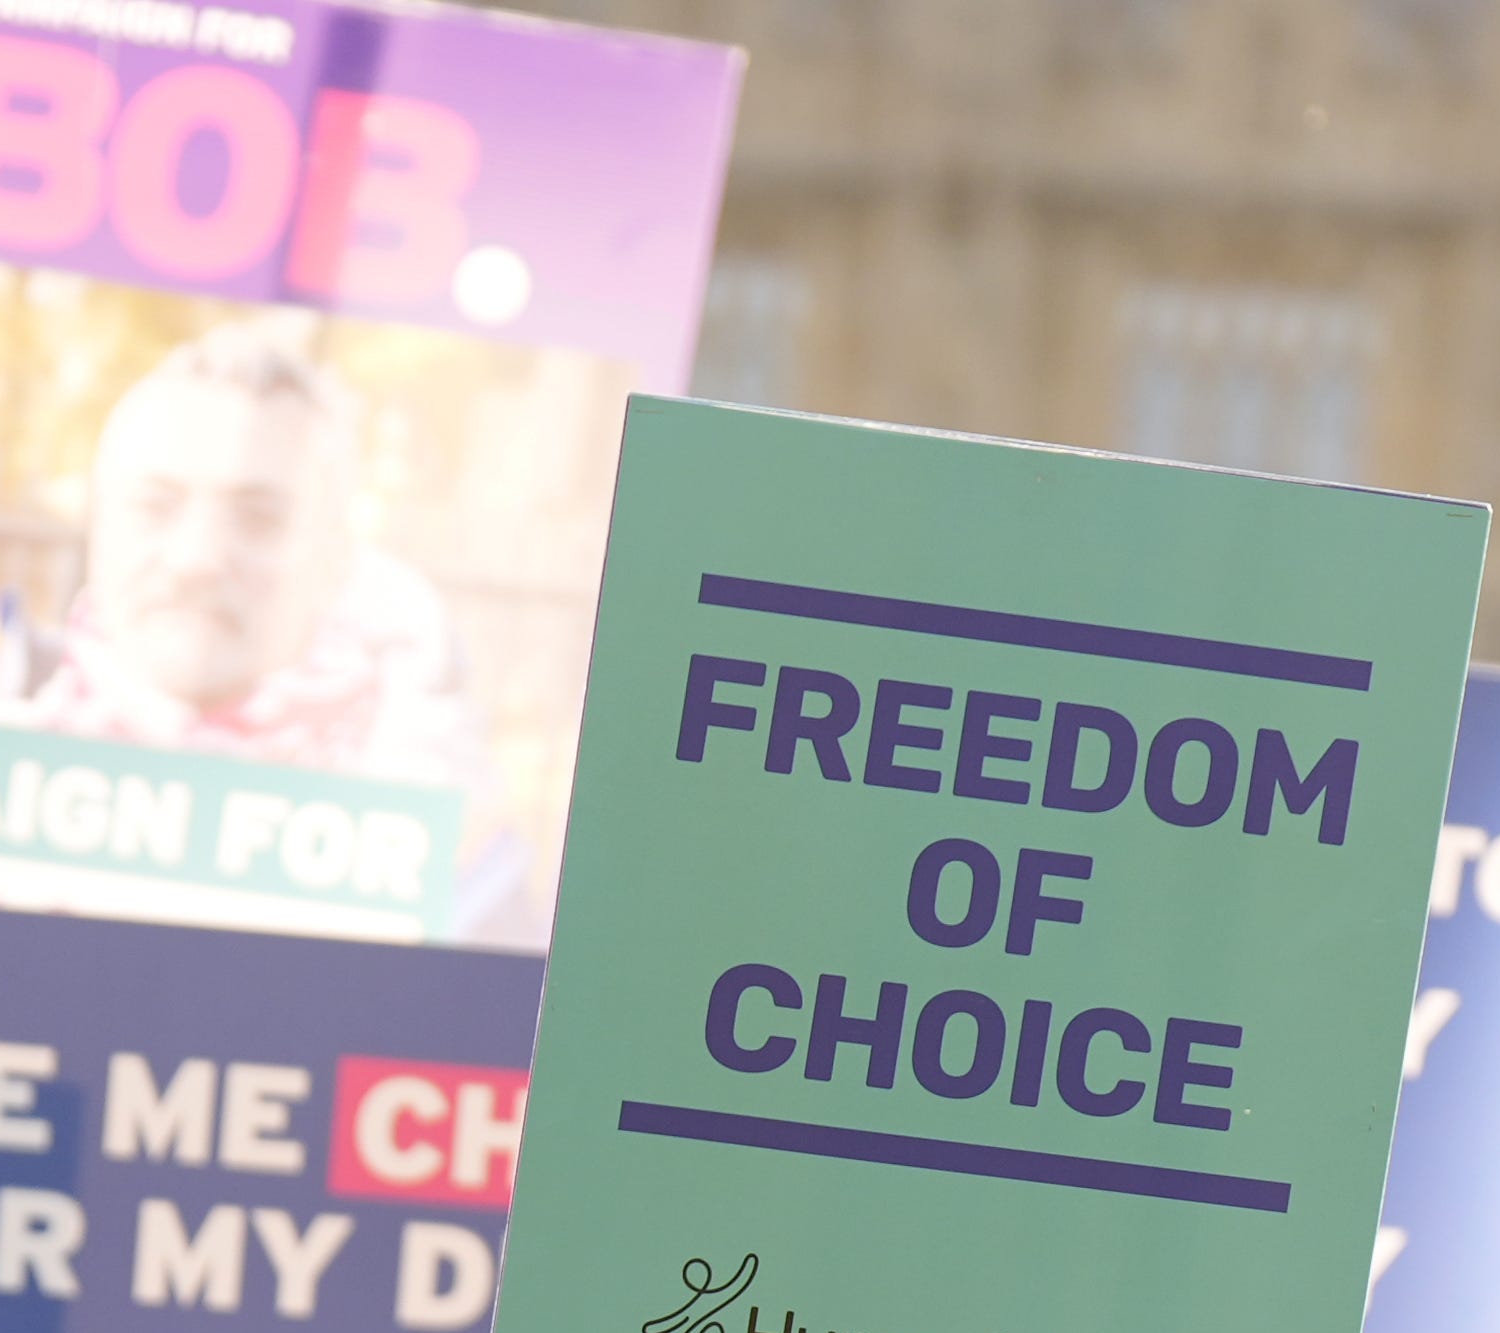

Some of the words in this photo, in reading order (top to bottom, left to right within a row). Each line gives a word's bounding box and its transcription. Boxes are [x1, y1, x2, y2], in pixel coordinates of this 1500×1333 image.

[674, 652, 1360, 847] FREEDOM
[213, 788, 432, 901] FOR
[905, 836, 1095, 958] OF
[703, 961, 1244, 1132] CHOICE
[101, 1052, 311, 1173] ME
[130, 1197, 354, 1319] MY
